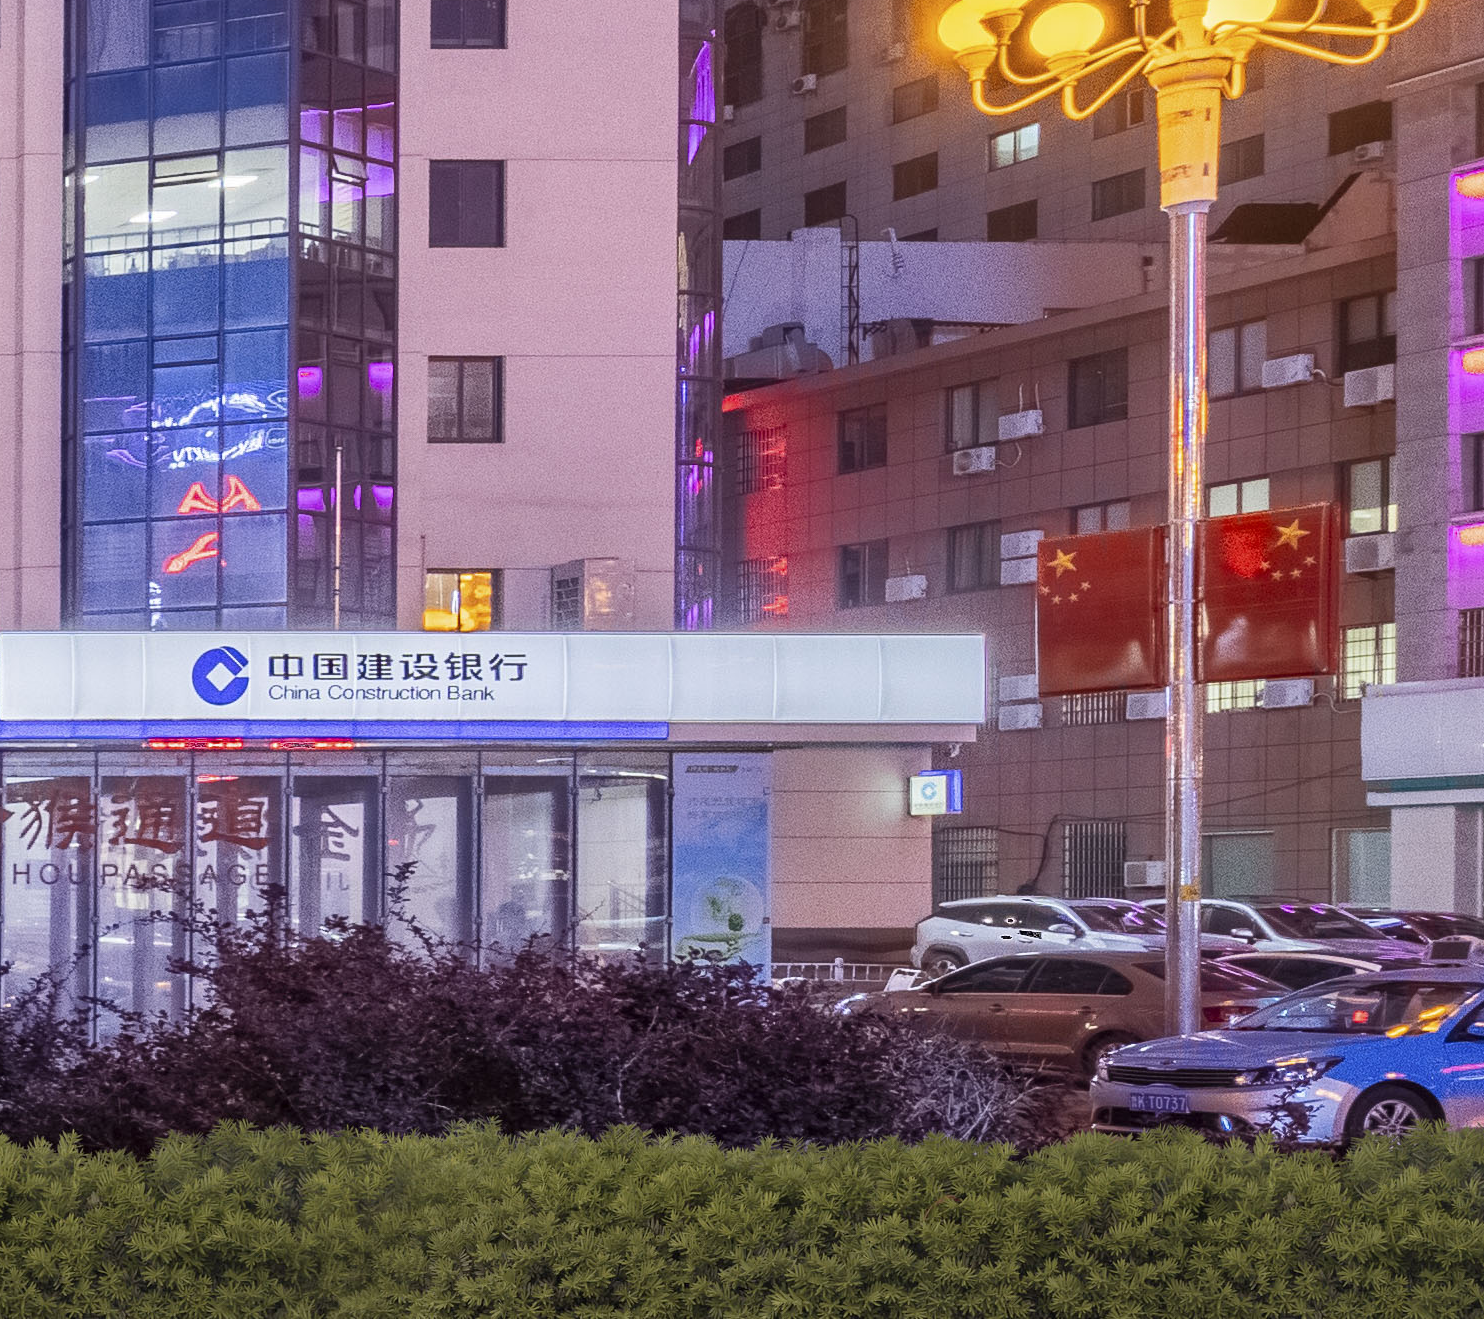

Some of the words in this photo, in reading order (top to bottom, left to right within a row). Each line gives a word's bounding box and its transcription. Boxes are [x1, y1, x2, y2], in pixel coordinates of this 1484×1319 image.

[268, 652, 527, 681] 中国建设银行
[268, 684, 321, 701] China
[328, 684, 441, 701] Construction
[447, 685, 495, 701] Bank
[100, 864, 271, 889] PASSAGE
